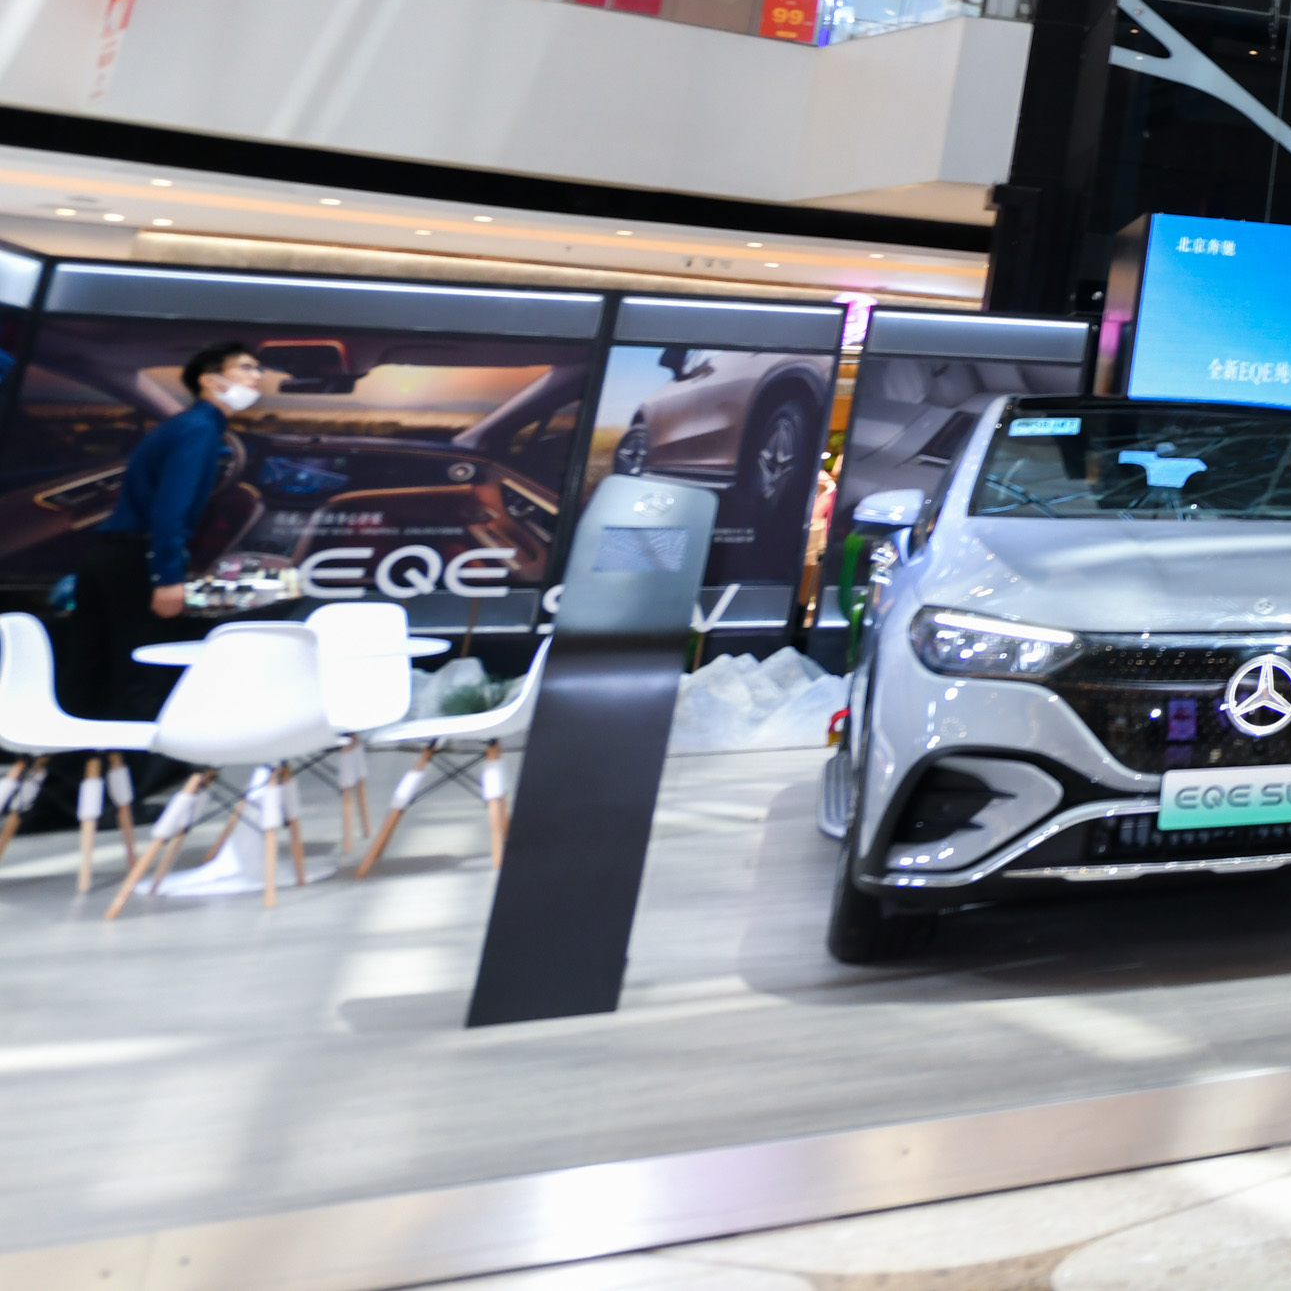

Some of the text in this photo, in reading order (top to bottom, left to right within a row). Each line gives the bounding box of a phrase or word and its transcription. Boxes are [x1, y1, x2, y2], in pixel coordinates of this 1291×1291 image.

[772, 7, 804, 25] 99
[1176, 236, 1237, 257] 北京奔驰
[298, 544, 517, 599] EQE
[1175, 784, 1250, 810] EQE
